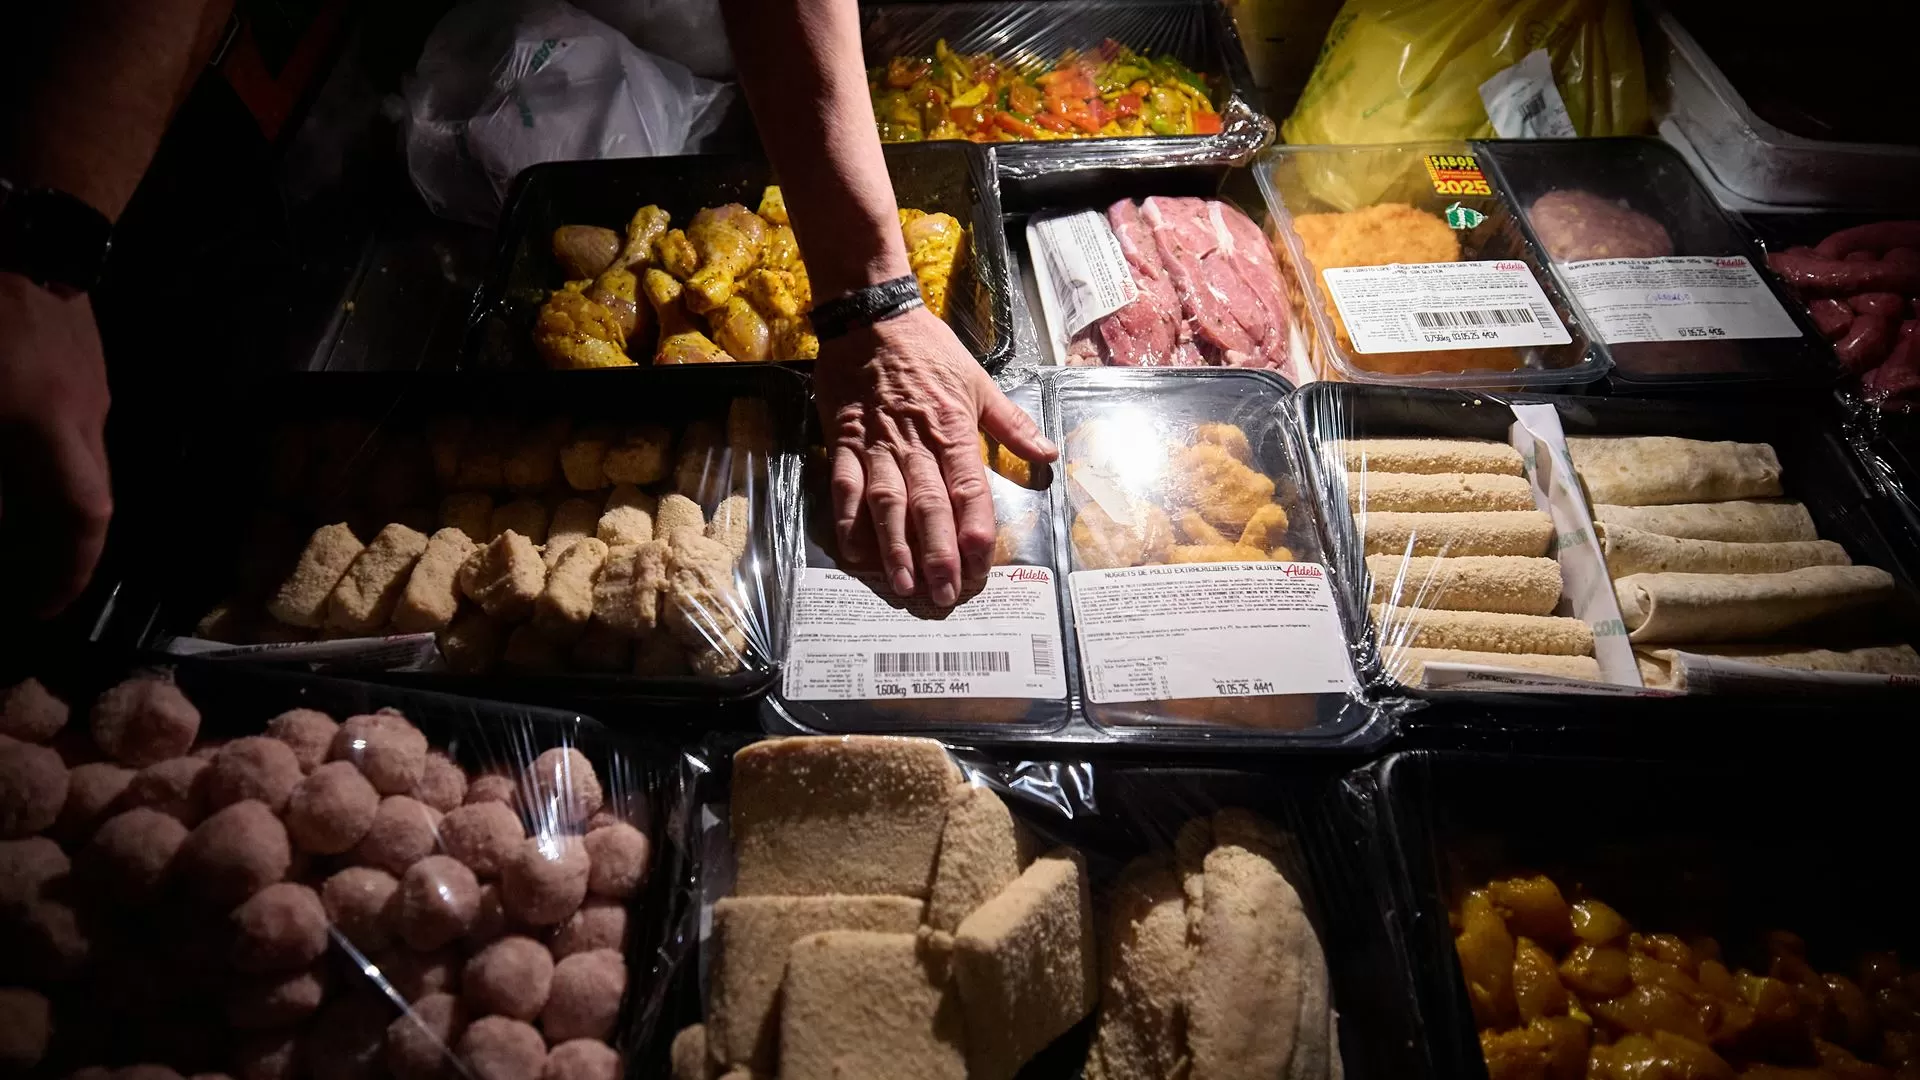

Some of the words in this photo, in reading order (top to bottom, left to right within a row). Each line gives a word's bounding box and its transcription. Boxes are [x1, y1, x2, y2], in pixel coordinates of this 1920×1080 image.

[1431, 156, 1477, 167] SABOR
[1433, 180, 1492, 195] 2025
[1007, 567, 1050, 582] Aldelis
[1105, 570, 1136, 579] NUGGETS
[1150, 567, 1172, 575] POLLO
[1256, 563, 1281, 572] GLUTEN
[1280, 563, 1322, 578] Aldelis
[912, 682, 945, 694] 10.05.25
[949, 682, 970, 694] 4441
[1216, 683, 1250, 695] 10.05.25
[1253, 682, 1274, 693] 4441
